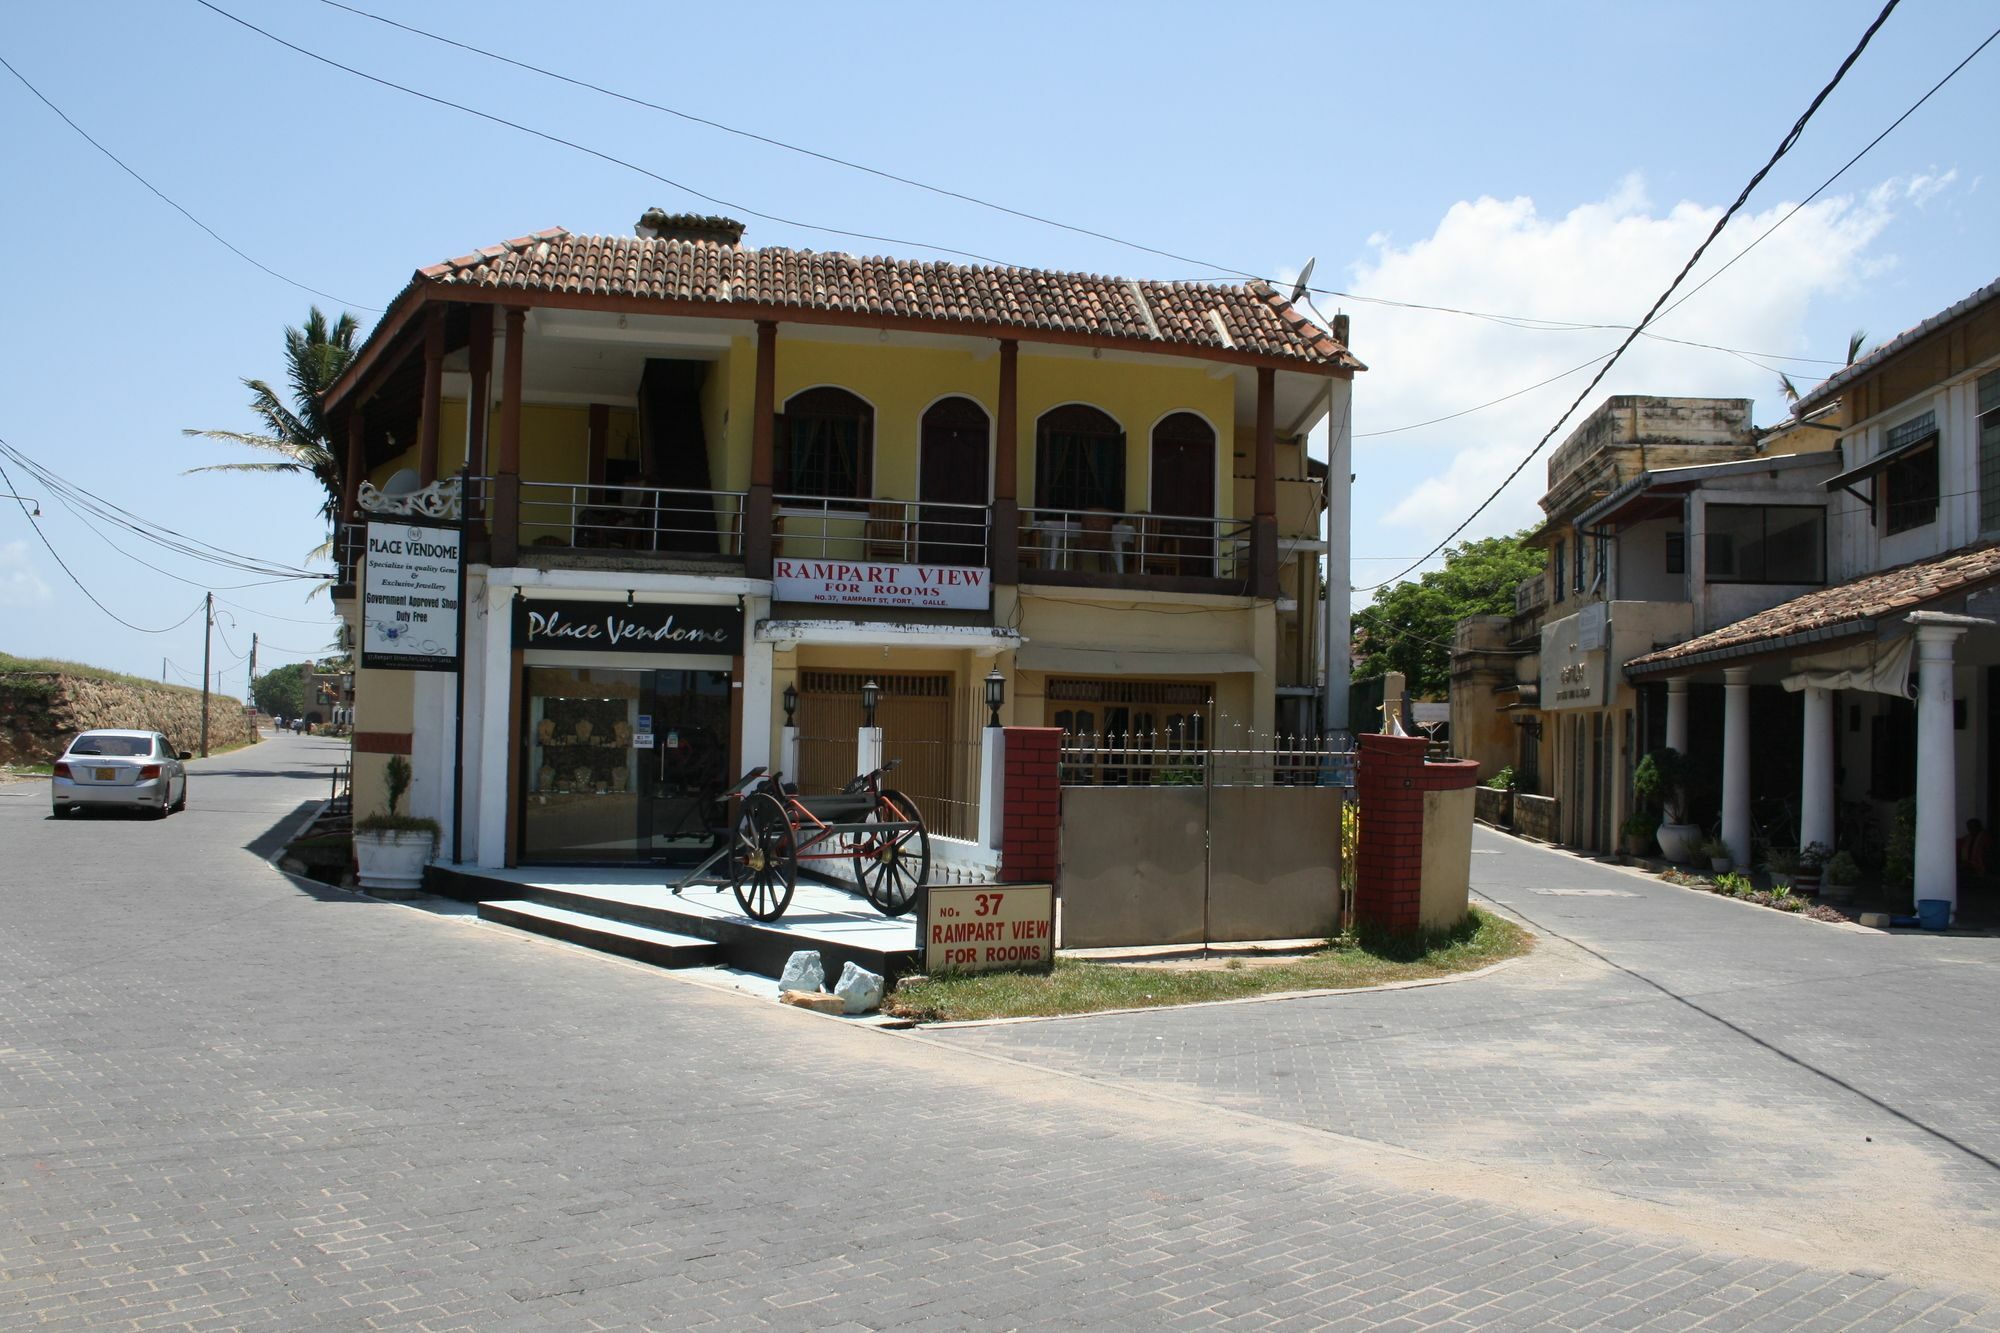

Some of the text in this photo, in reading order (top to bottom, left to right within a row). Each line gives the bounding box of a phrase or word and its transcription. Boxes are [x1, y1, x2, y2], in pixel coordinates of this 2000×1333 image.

[369, 538, 458, 559] PLACE VENDOME
[369, 560, 404, 570] Specialize
[414, 564, 439, 574] quality
[439, 566, 457, 574] Gems
[777, 561, 984, 587] RAMPART VIEW
[381, 579, 446, 591] Exclusive Jewellery
[824, 582, 940, 597] FOR ROOMS
[367, 592, 458, 610] Government Approved Shop
[396, 611, 428, 622] Duty Free
[528, 611, 728, 645] Place Vendome
[974, 893, 1004, 917] 37
[932, 920, 1049, 944] RAMPART VIEW
[945, 945, 1040, 964] FOR ROOMS
